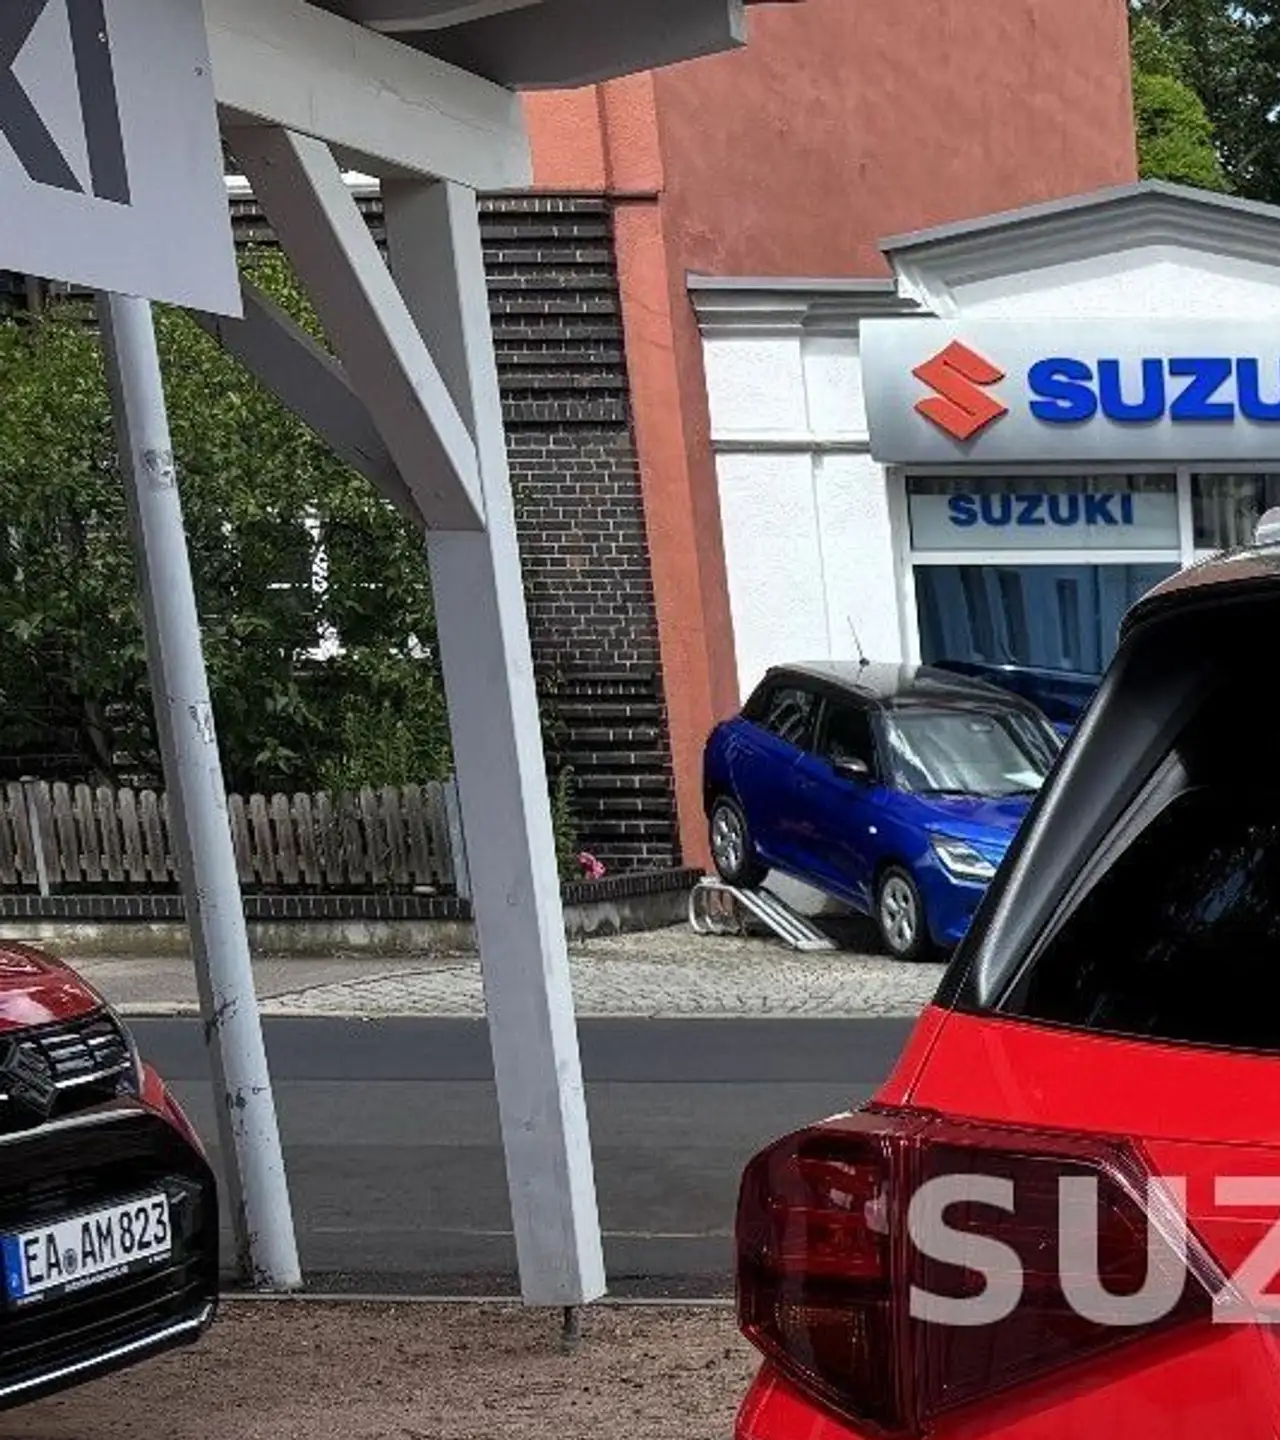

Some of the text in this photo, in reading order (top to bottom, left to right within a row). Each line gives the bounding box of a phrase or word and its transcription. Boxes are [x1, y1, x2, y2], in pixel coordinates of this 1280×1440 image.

[948, 493, 1134, 527] SUZUKI
[24, 1231, 63, 1285] EA
[81, 1216, 116, 1269] AM
[119, 1201, 167, 1254] 823
